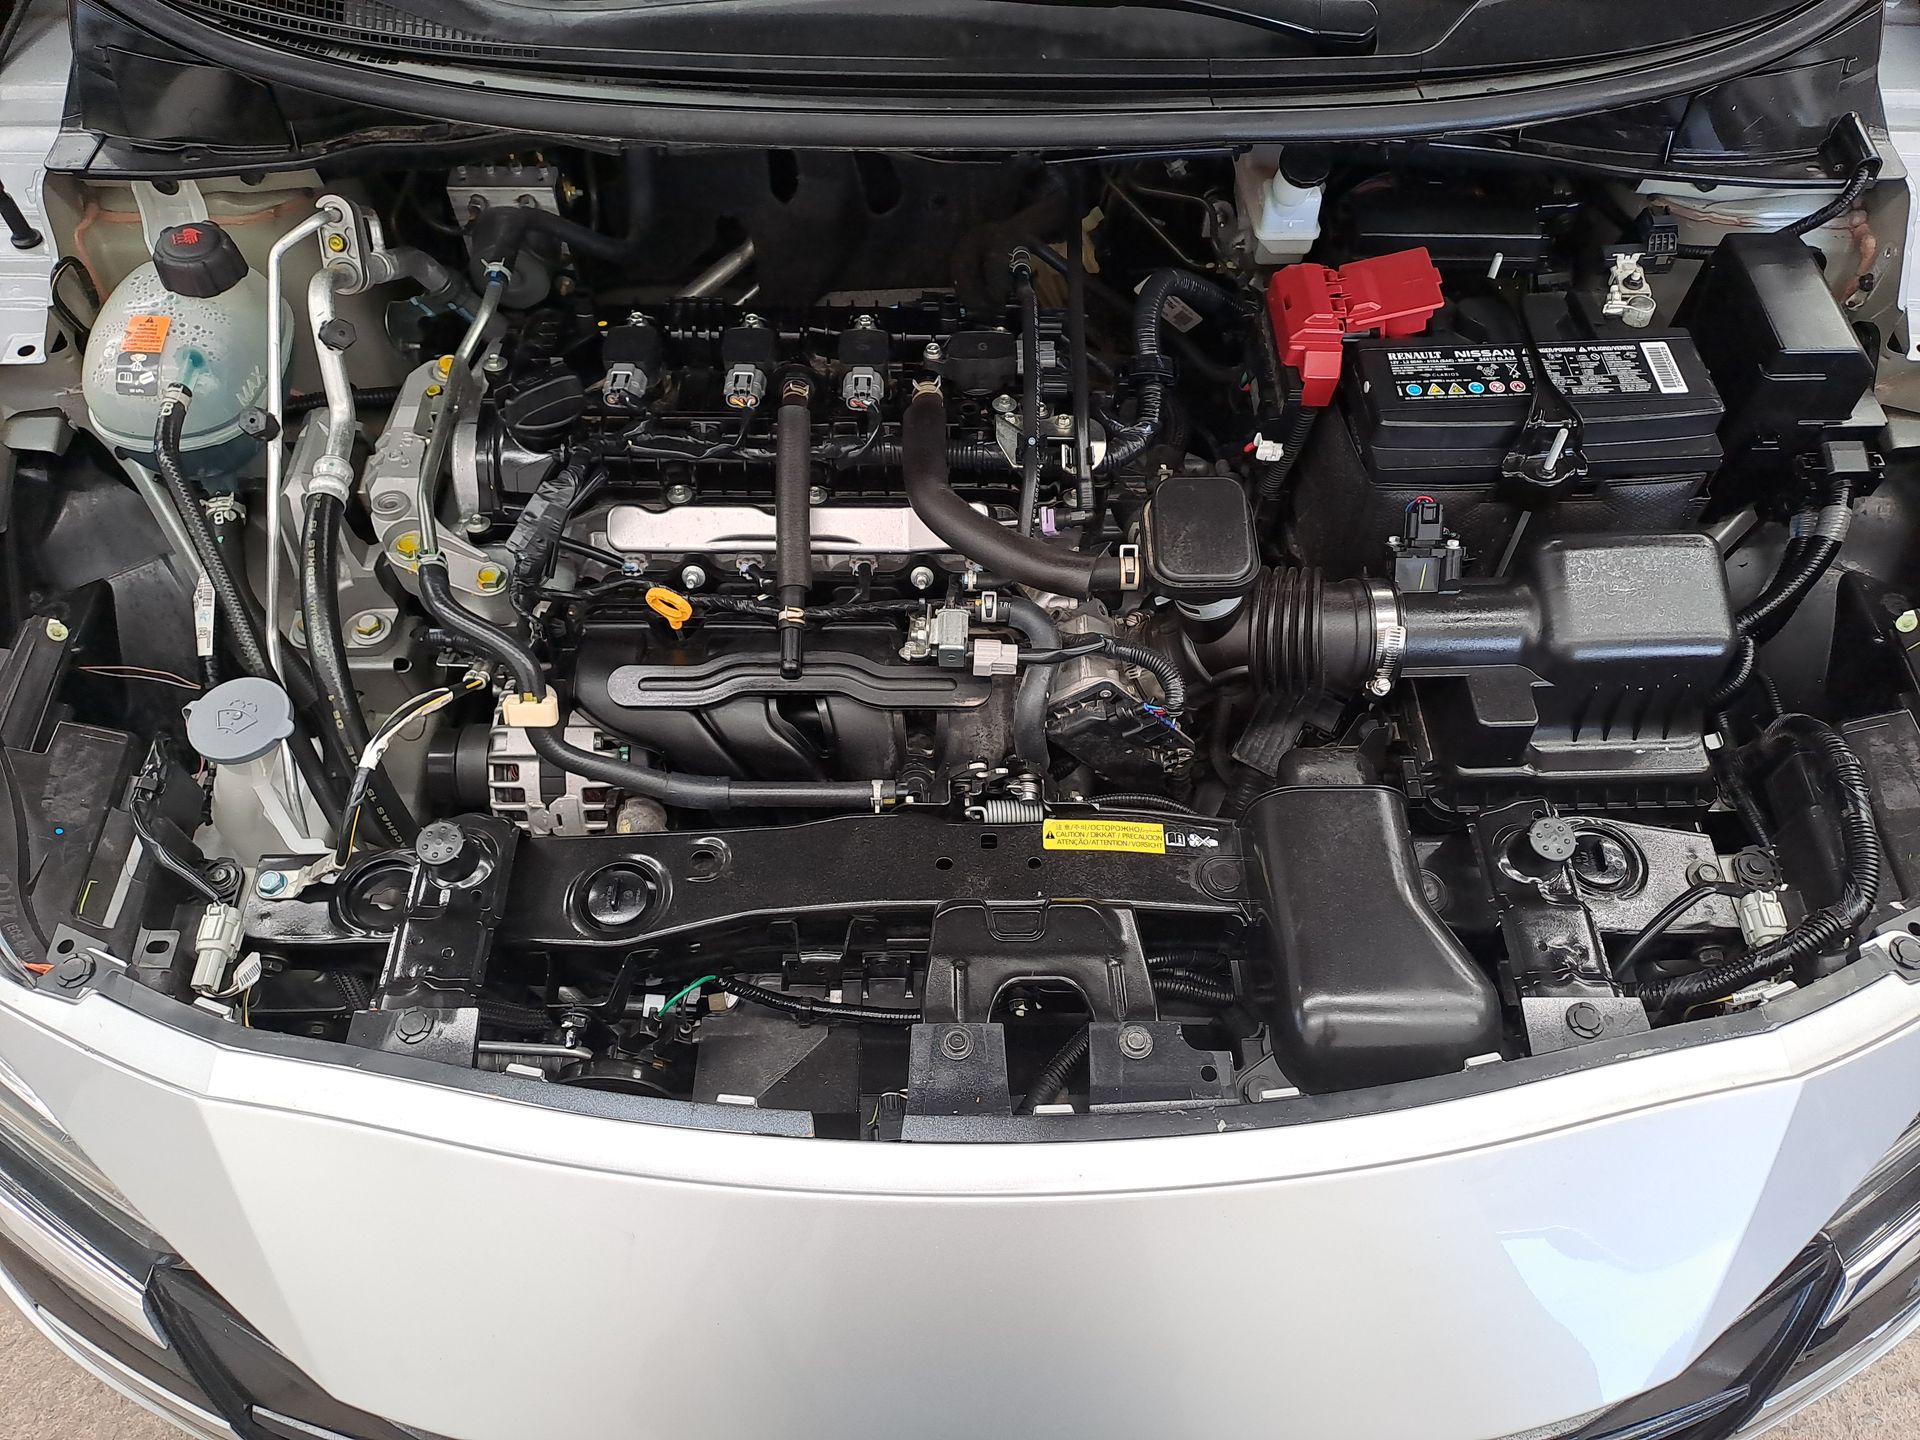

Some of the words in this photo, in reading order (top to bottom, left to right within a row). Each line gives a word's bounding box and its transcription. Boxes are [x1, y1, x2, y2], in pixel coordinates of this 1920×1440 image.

[1386, 351, 1442, 361] RENAULT
[1453, 348, 1515, 358] NISSAN
[236, 365, 262, 407] MAX
